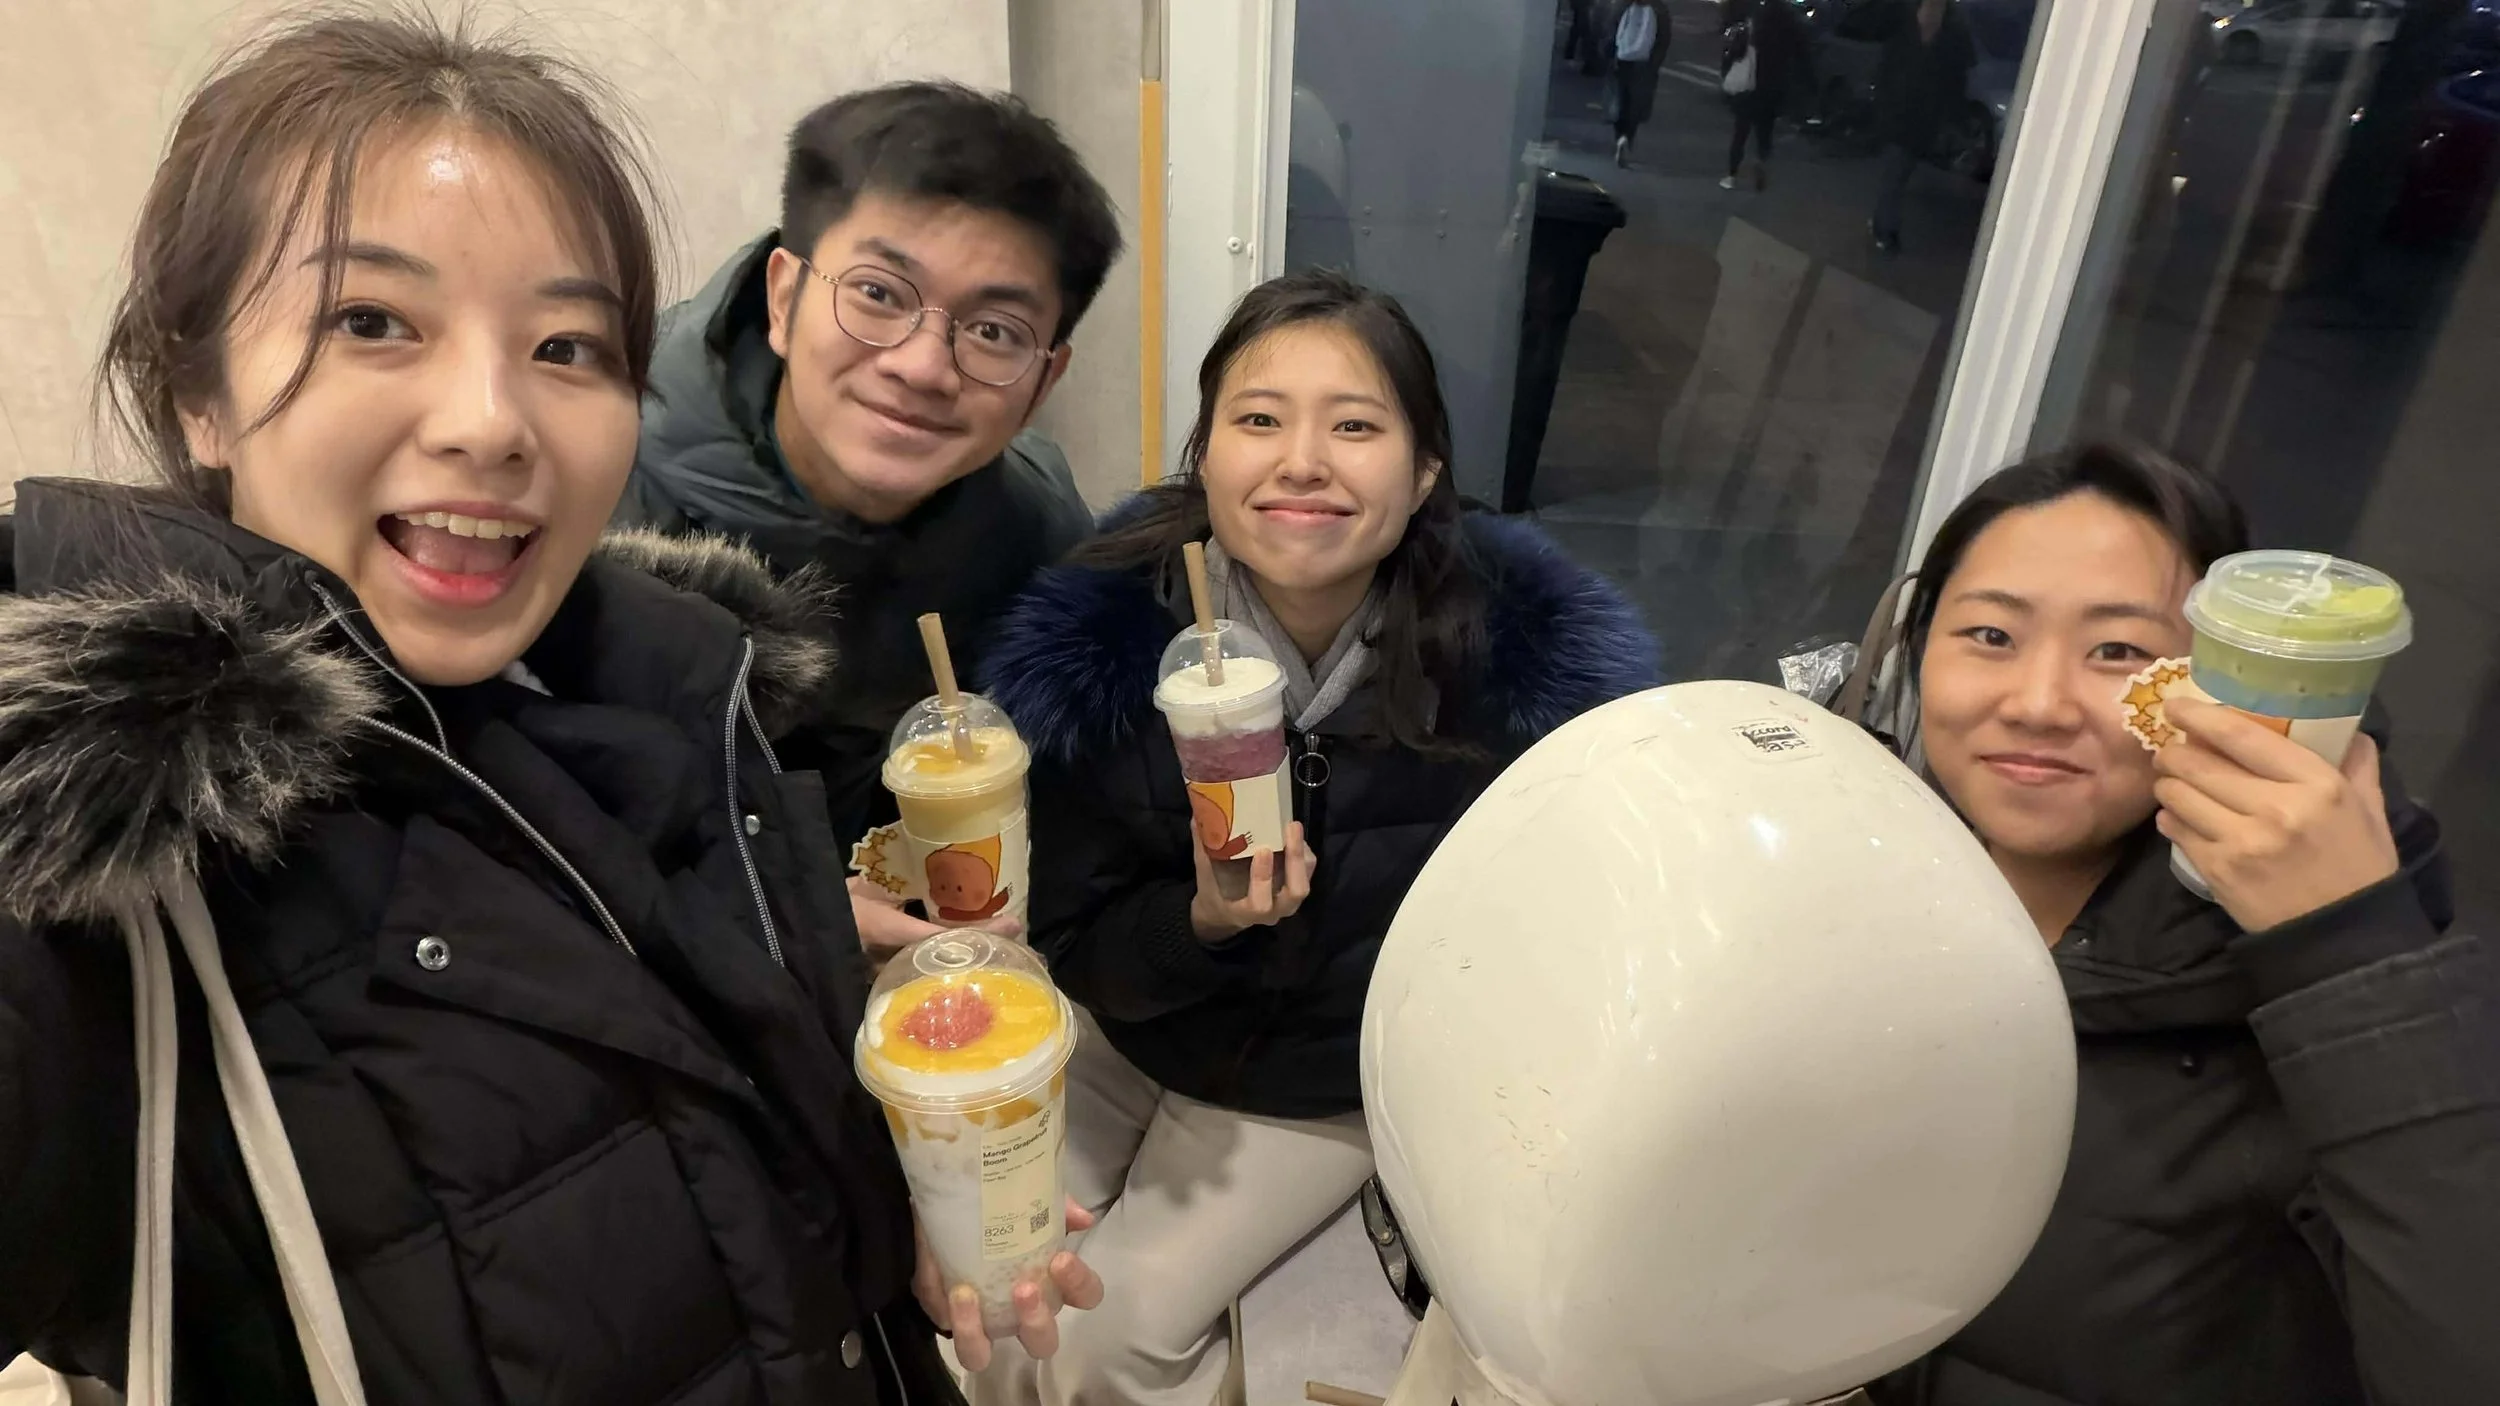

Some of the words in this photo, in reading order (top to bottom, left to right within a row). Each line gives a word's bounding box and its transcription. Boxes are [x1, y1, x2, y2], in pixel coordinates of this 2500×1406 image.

[983, 1147, 1012, 1159] Mango
[1013, 1127, 1048, 1151] Grapefruit
[983, 1157, 1008, 1167] Boom
[984, 1224, 1014, 1238] 8263
